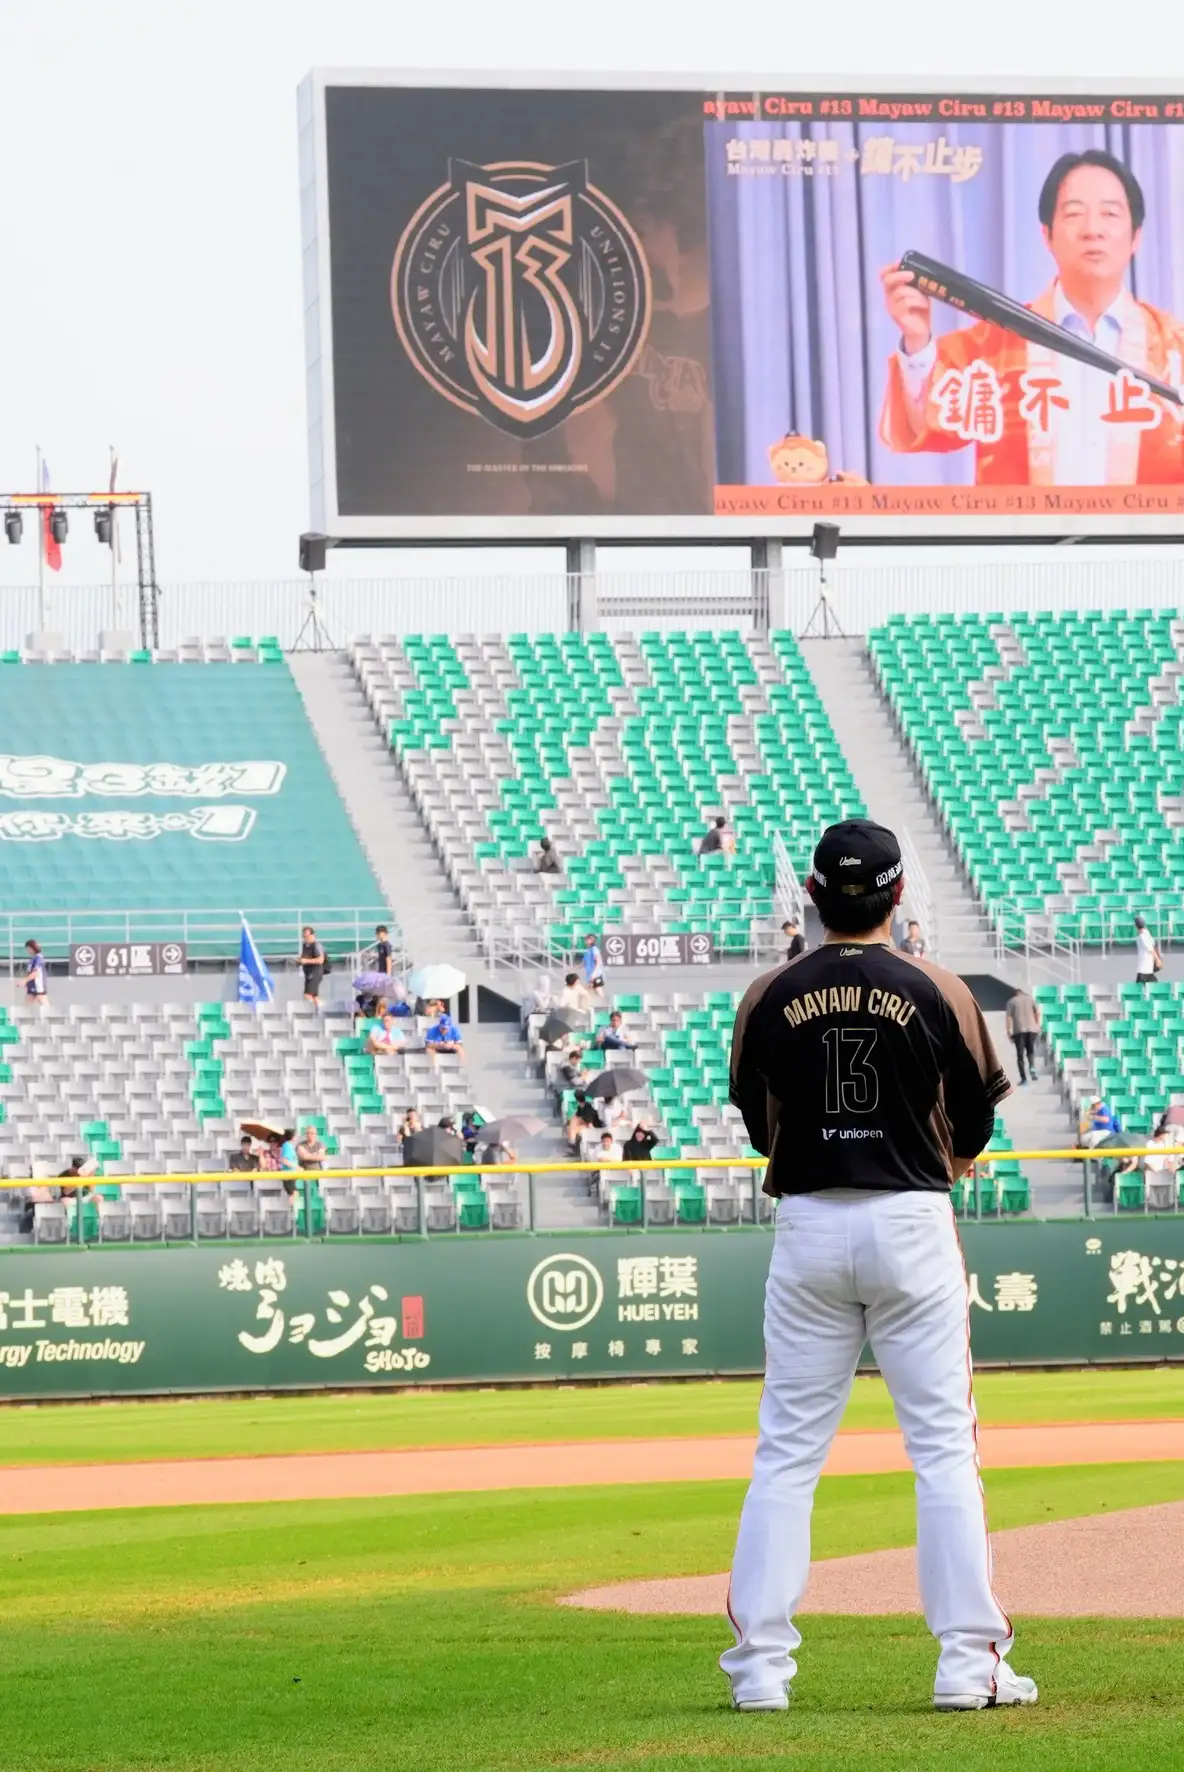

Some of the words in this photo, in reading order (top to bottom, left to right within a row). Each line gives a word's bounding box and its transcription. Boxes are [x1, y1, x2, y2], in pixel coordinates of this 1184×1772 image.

[704, 101, 757, 119] ayaw
[765, 98, 813, 115] Ciru
[820, 99, 852, 115] #13
[859, 99, 932, 119] Mayaw
[939, 100, 986, 116] Ciru
[992, 100, 1025, 116] #13
[1032, 100, 1104, 120] Mayaw
[1111, 102, 1158, 117] Ciru
[420, 224, 450, 274] CIRU
[590, 226, 625, 334] UNILIONS
[417, 285, 456, 363] MAYAW
[716, 499, 769, 513] ayaw
[778, 494, 824, 510] Ciru
[832, 496, 863, 510] #13
[872, 495, 941, 512] Mayaw
[952, 494, 996, 509] Ciru
[1005, 496, 1036, 509] #13
[1044, 495, 1115, 512] Mayaw
[1123, 494, 1168, 509] Ciru
[106, 945, 152, 967] 61區
[637, 936, 681, 957] 60區
[783, 986, 861, 1029] MAYAW
[868, 988, 916, 1027] CIRU
[822, 1028, 879, 1113] 13
[839, 1128, 883, 1139] uniopen
[617, 1256, 698, 1298] 輝葉
[0, 1286, 129, 1330] 士電機
[618, 1304, 659, 1322] HUEI
[663, 1303, 698, 1321] YEH
[0, 1345, 32, 1367] rgy
[36, 1338, 145, 1363] Technology
[363, 1347, 431, 1372] SHOJO
[534, 1338, 699, 1359] 按摩椅專家
